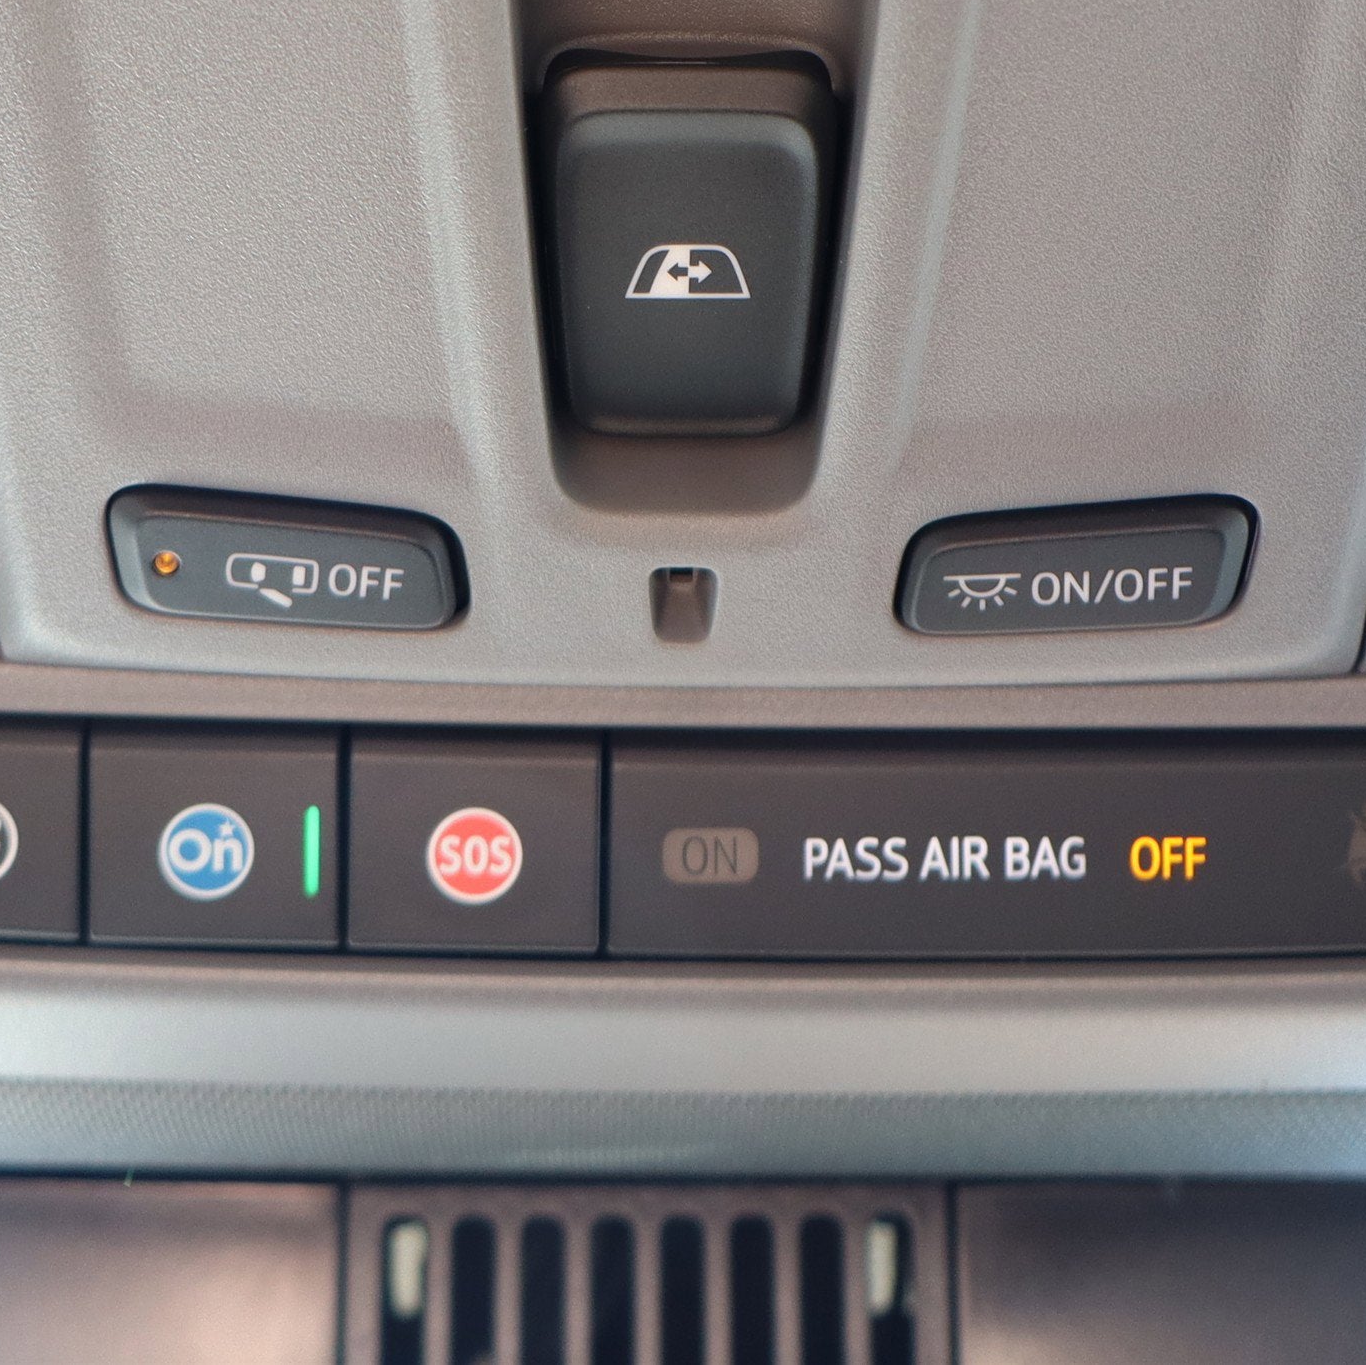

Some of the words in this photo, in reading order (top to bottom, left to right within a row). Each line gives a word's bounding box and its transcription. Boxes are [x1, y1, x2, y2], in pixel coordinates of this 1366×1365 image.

[328, 563, 405, 601] OFF
[1031, 566, 1193, 606] ON/OFF
[438, 833, 513, 876] SOS
[681, 835, 740, 875] ON
[803, 836, 909, 881] PASS
[919, 836, 992, 881] AIR
[1003, 836, 1087, 881] BAG
[1129, 835, 1207, 881] OFF
